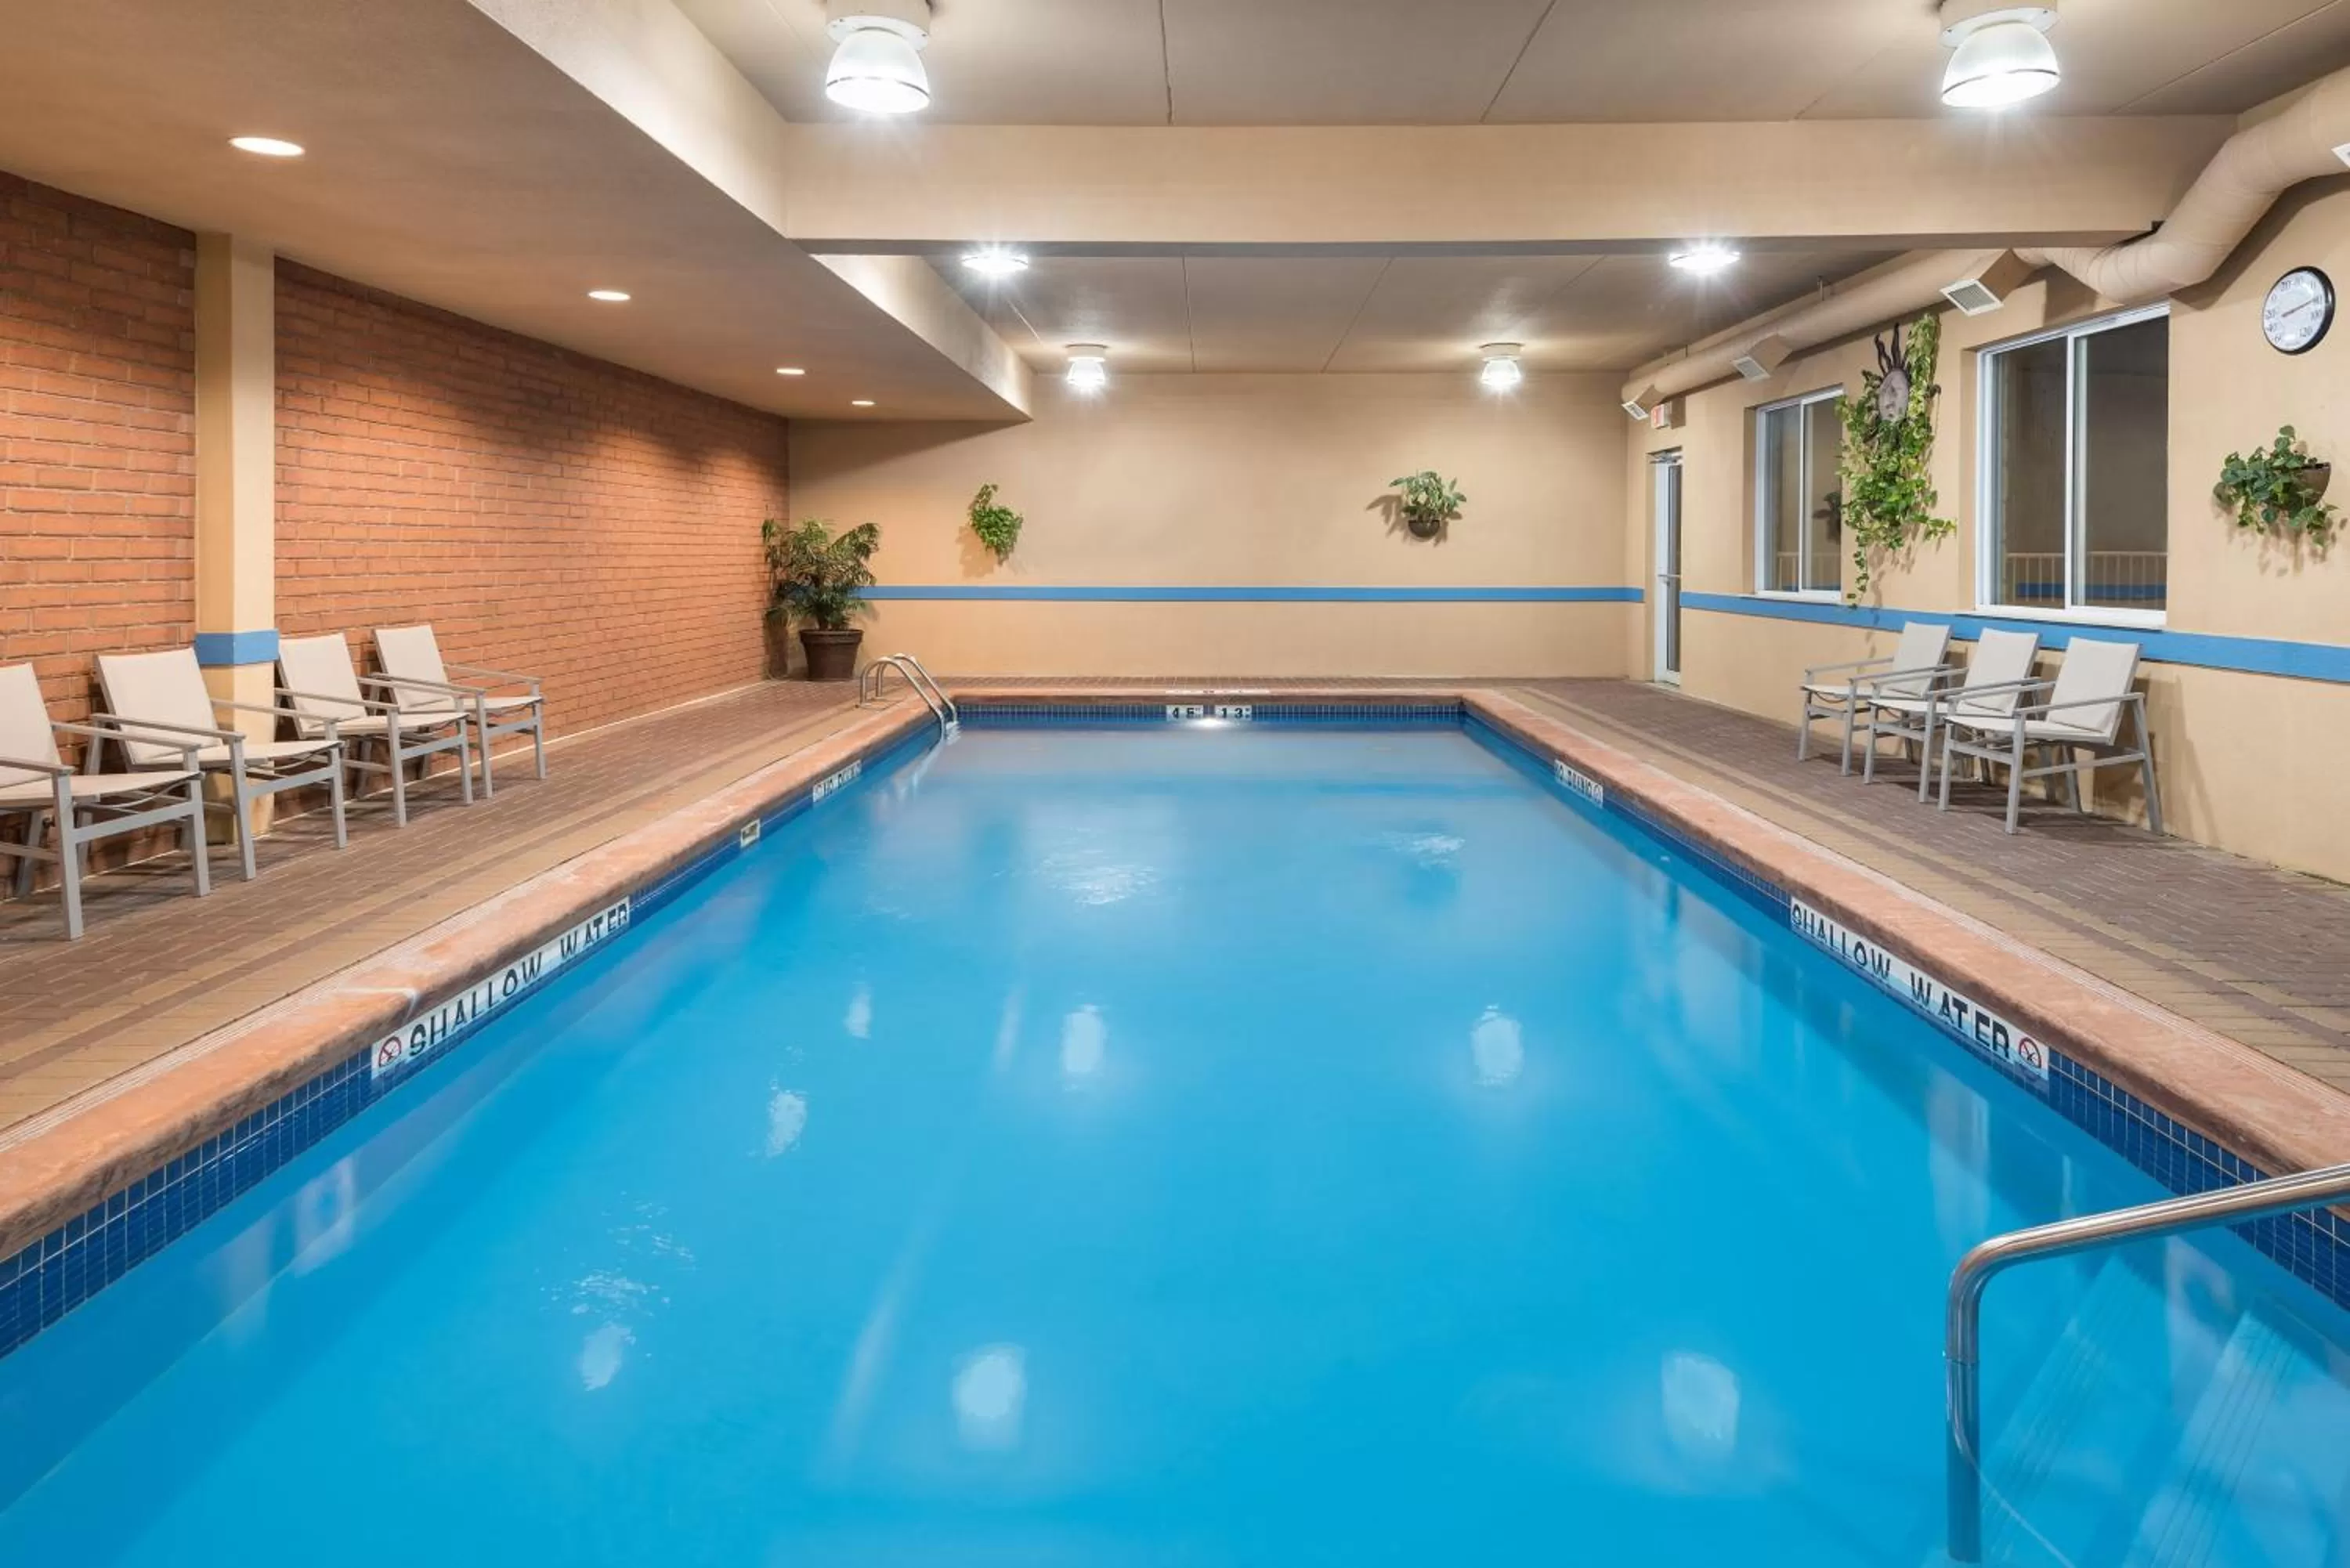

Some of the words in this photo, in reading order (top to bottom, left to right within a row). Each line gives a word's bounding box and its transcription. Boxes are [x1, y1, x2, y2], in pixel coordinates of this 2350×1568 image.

[409, 952, 542, 1057] SHALLOW
[560, 903, 629, 959] WATER
[1791, 904, 1891, 979] SHALLOW
[1911, 972, 2009, 1058] WATER
